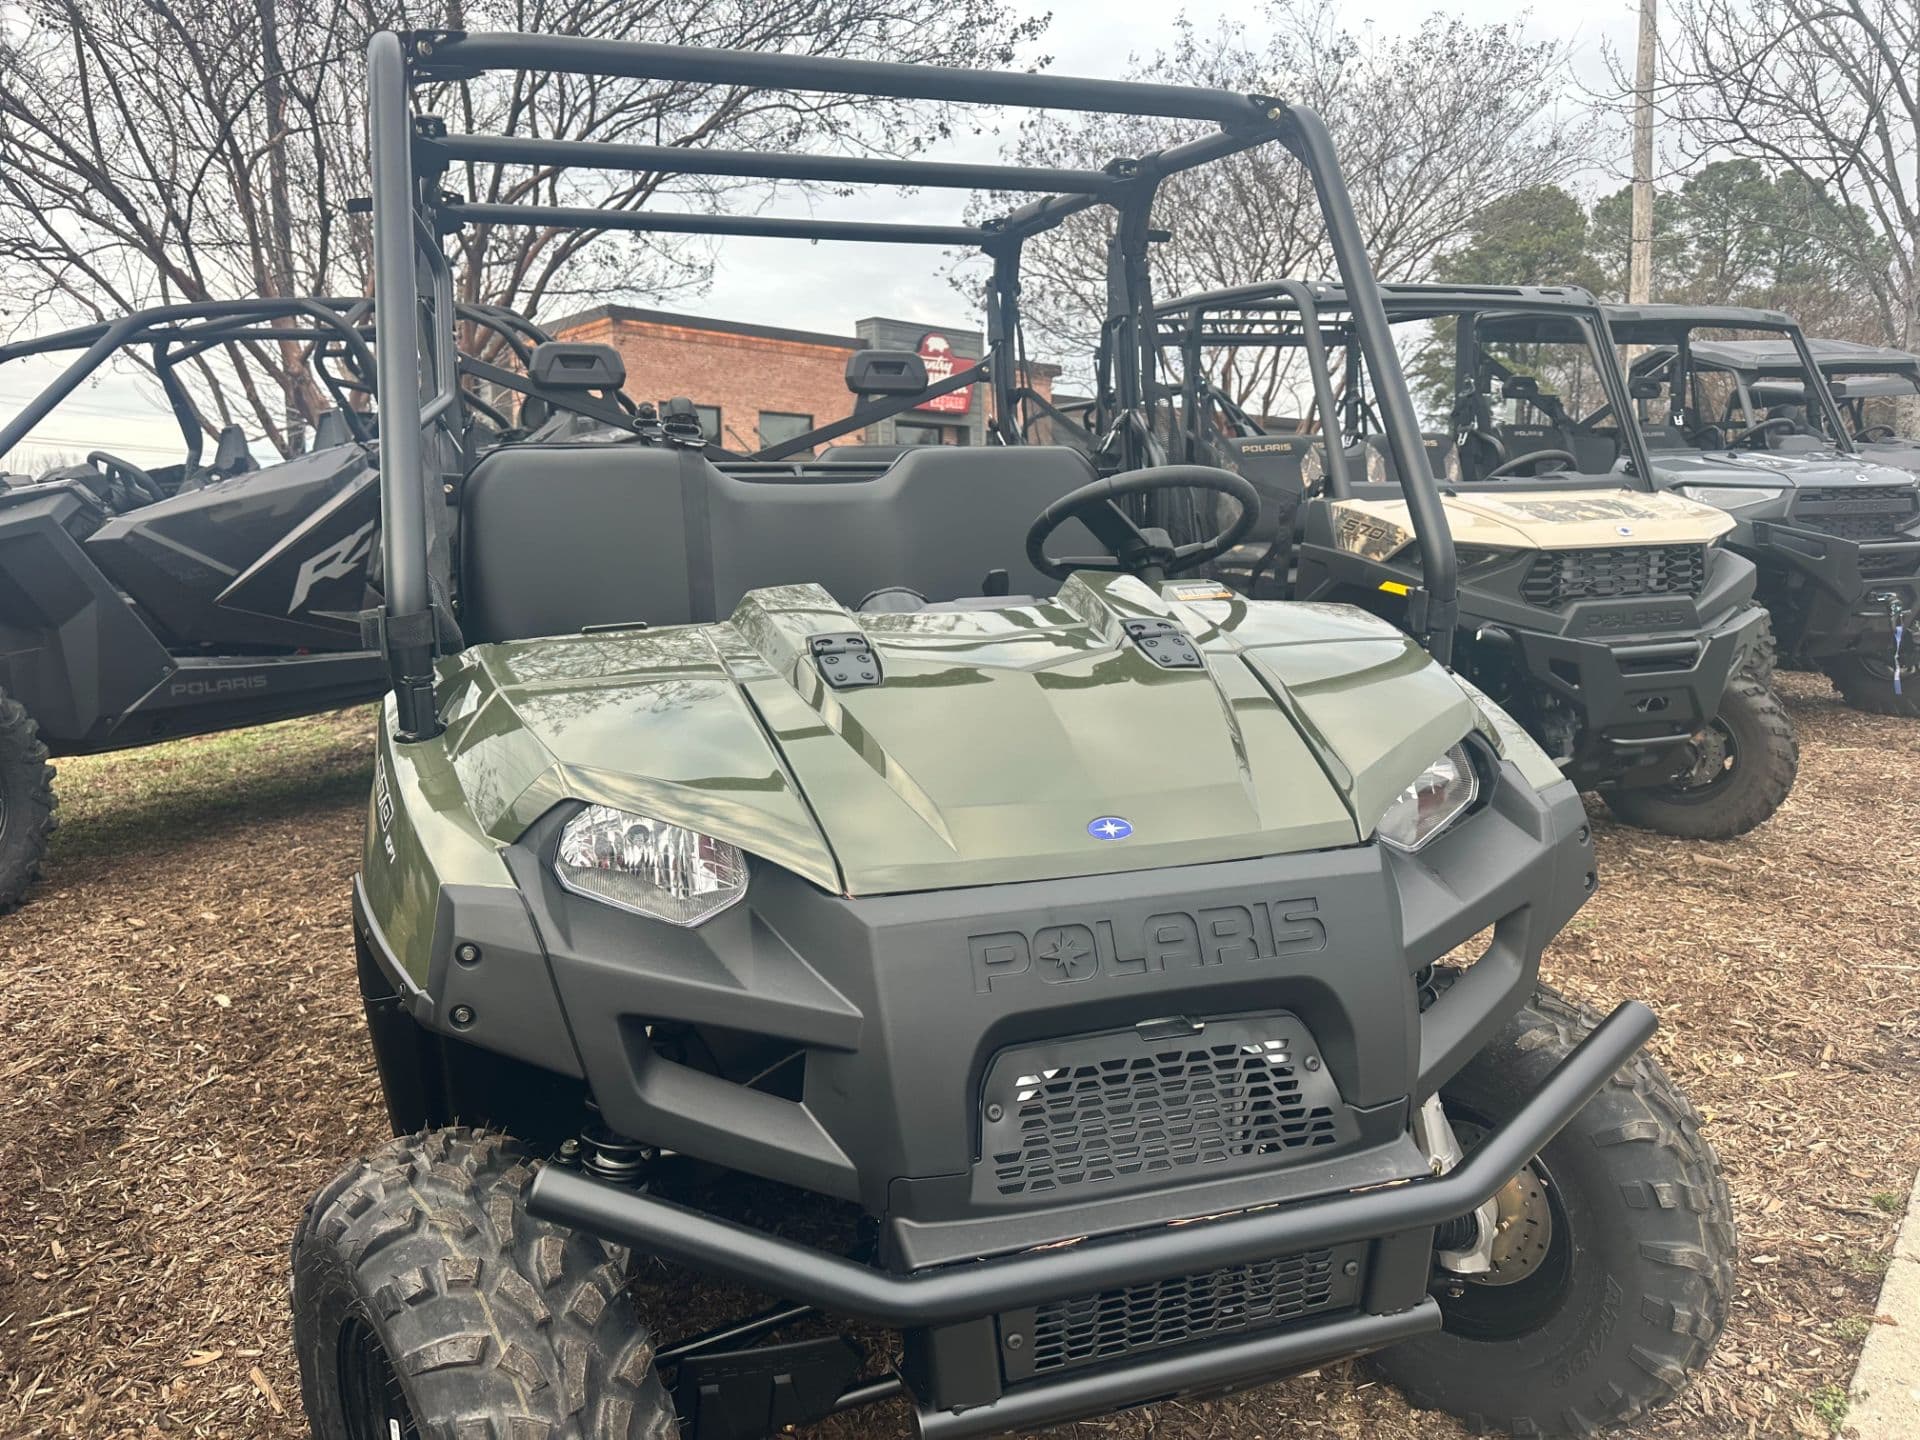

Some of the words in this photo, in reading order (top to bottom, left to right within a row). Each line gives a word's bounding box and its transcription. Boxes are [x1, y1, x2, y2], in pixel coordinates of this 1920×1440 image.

[1241, 443, 1292, 454] POLARIS
[1342, 517, 1387, 541] 570
[1586, 607, 1686, 634] POLARIS
[170, 675, 268, 697] POLARIS
[967, 896, 1328, 997] POLARIS
